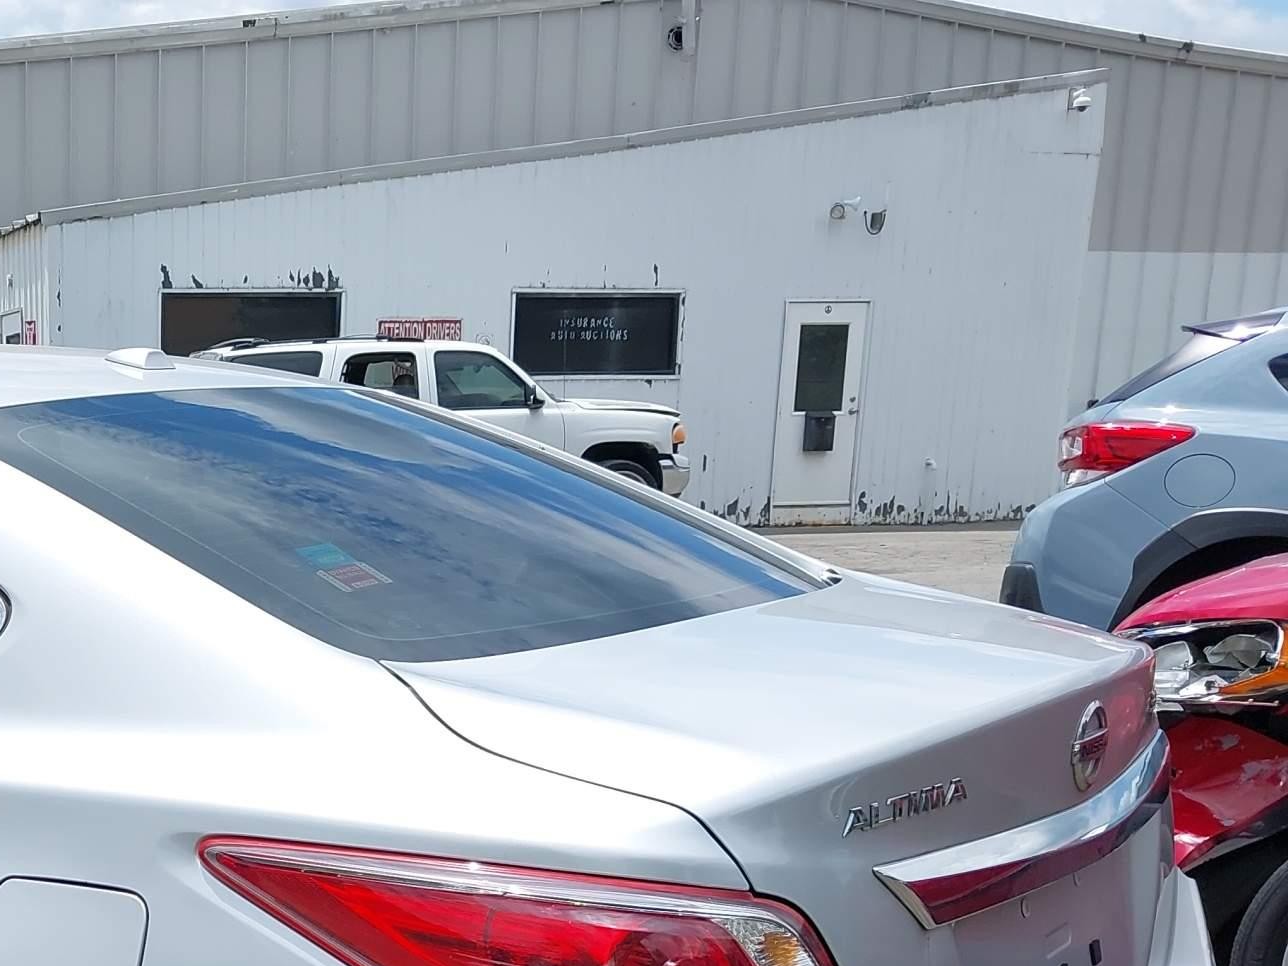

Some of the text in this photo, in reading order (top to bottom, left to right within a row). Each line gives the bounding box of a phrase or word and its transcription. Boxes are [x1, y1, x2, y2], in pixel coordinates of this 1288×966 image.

[380, 322, 462, 341] ATTENTION DRIVERS
[560, 316, 616, 328] INSURANCE
[842, 777, 968, 838] ALTIMA
